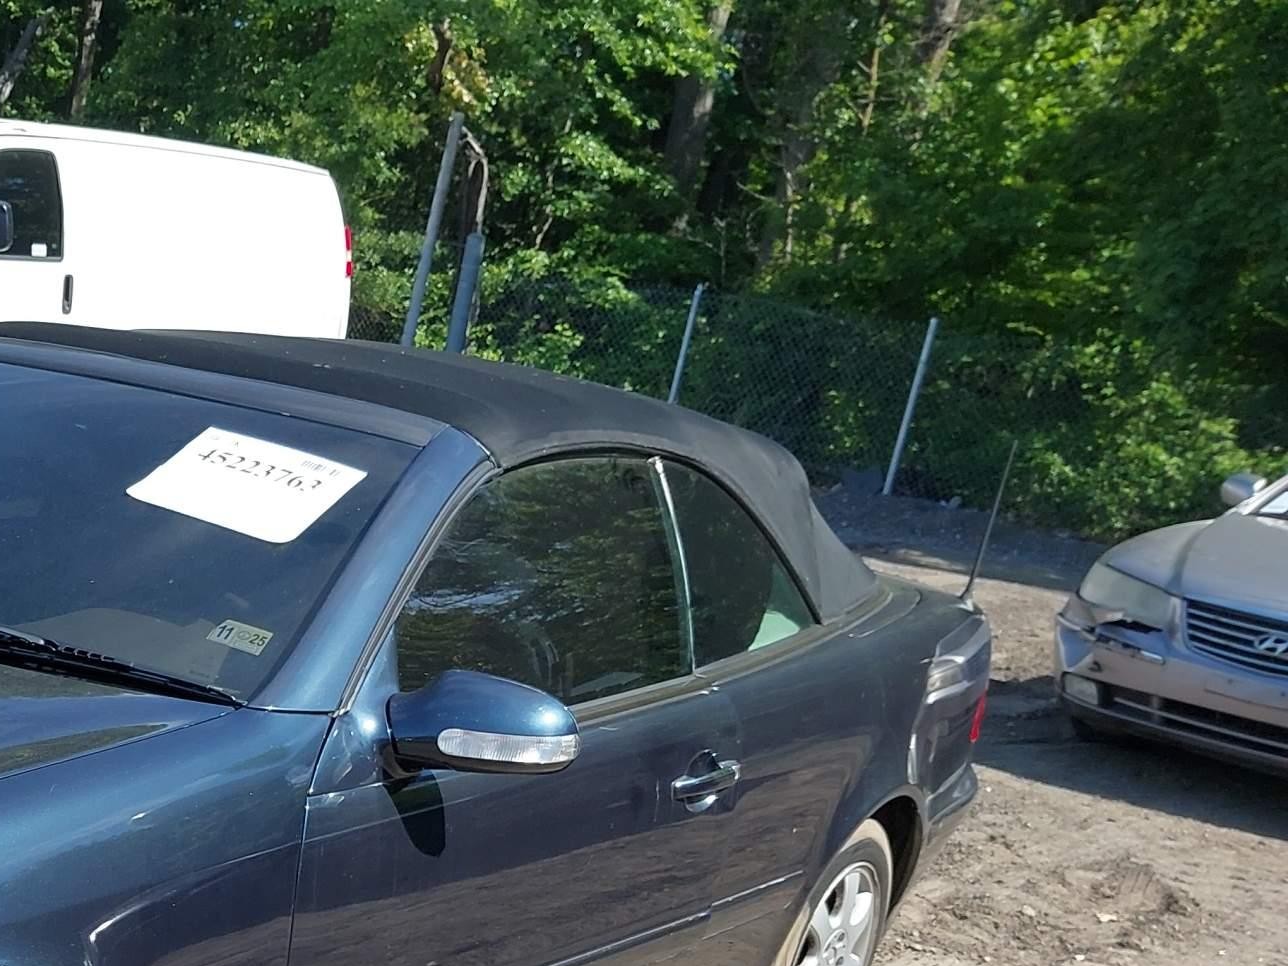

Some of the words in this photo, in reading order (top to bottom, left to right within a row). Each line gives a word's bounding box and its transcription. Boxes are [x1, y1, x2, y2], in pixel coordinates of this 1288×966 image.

[198, 448, 323, 491] 45223763
[216, 624, 234, 640] 11
[249, 633, 269, 647] 25
